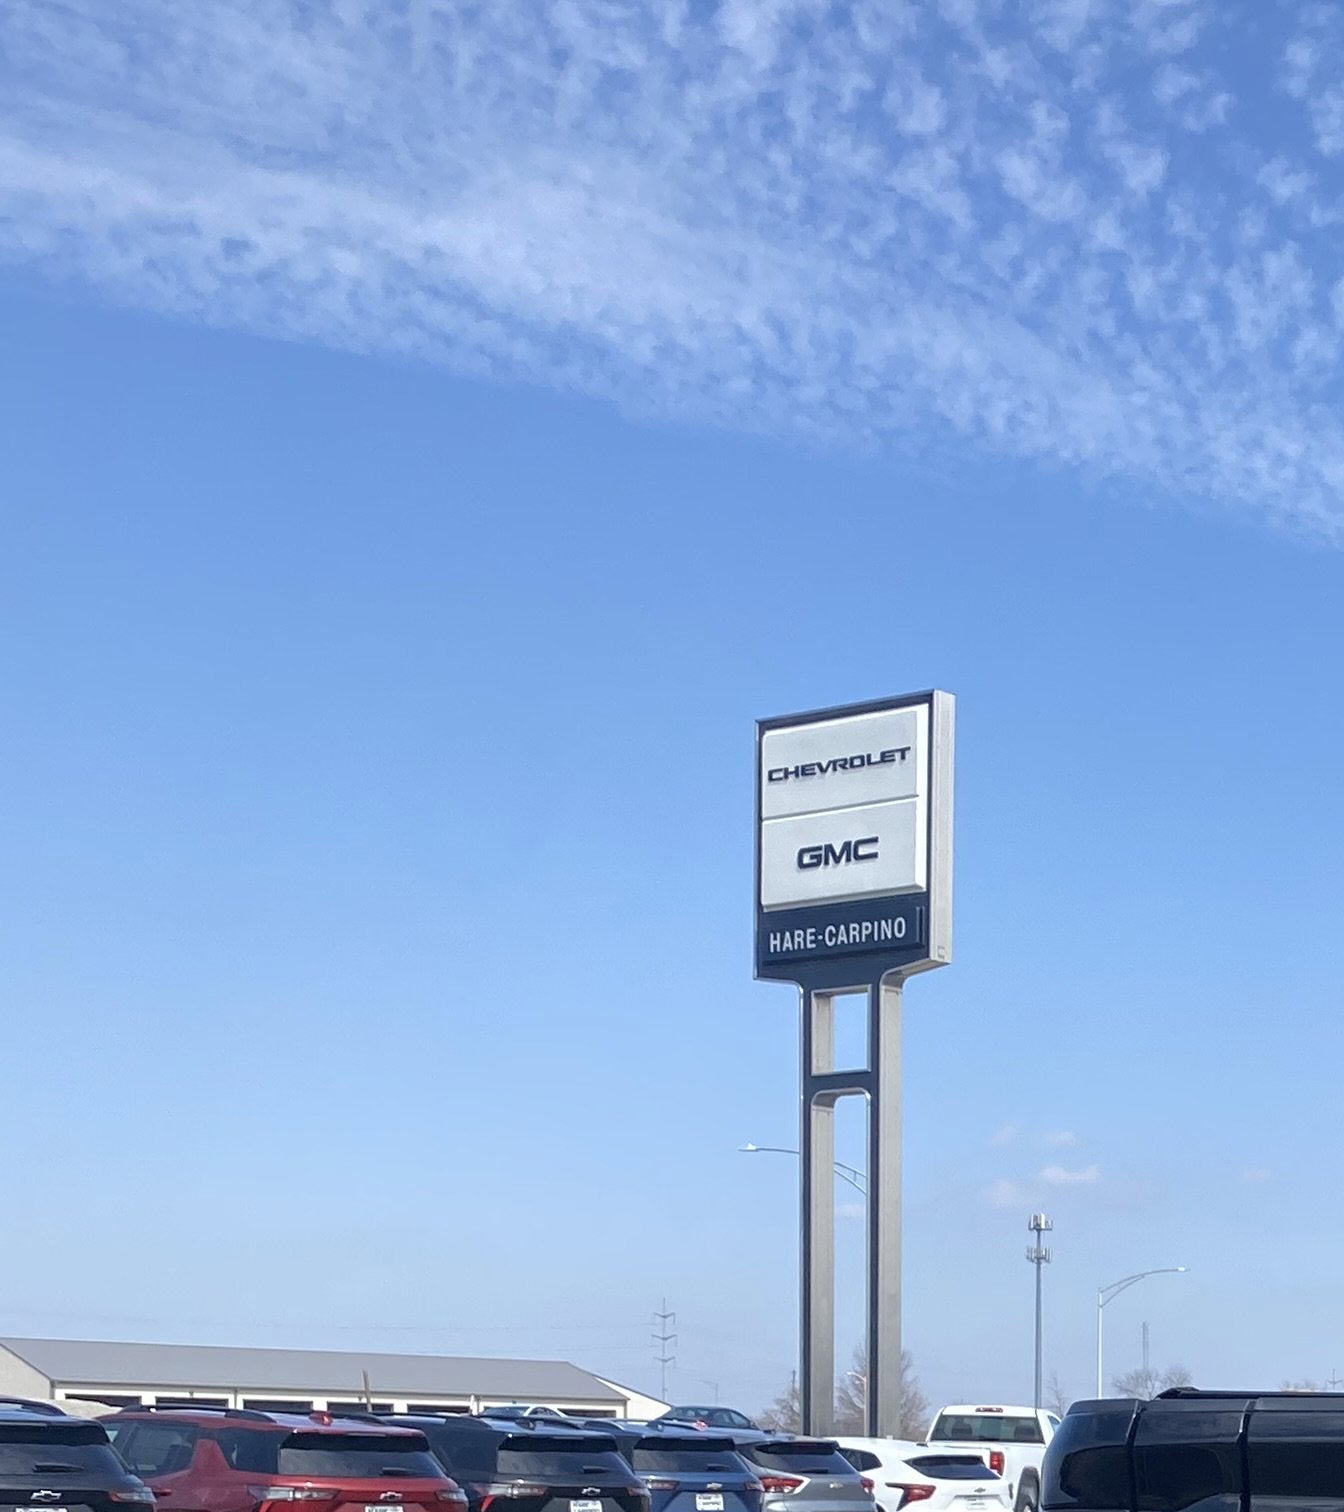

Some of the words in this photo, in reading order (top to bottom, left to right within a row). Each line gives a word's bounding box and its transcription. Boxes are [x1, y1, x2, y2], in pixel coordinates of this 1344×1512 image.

[767, 746, 911, 782] CHEVROLET
[797, 836, 879, 869] GMC
[769, 917, 906, 953] HARE-CARPINO
